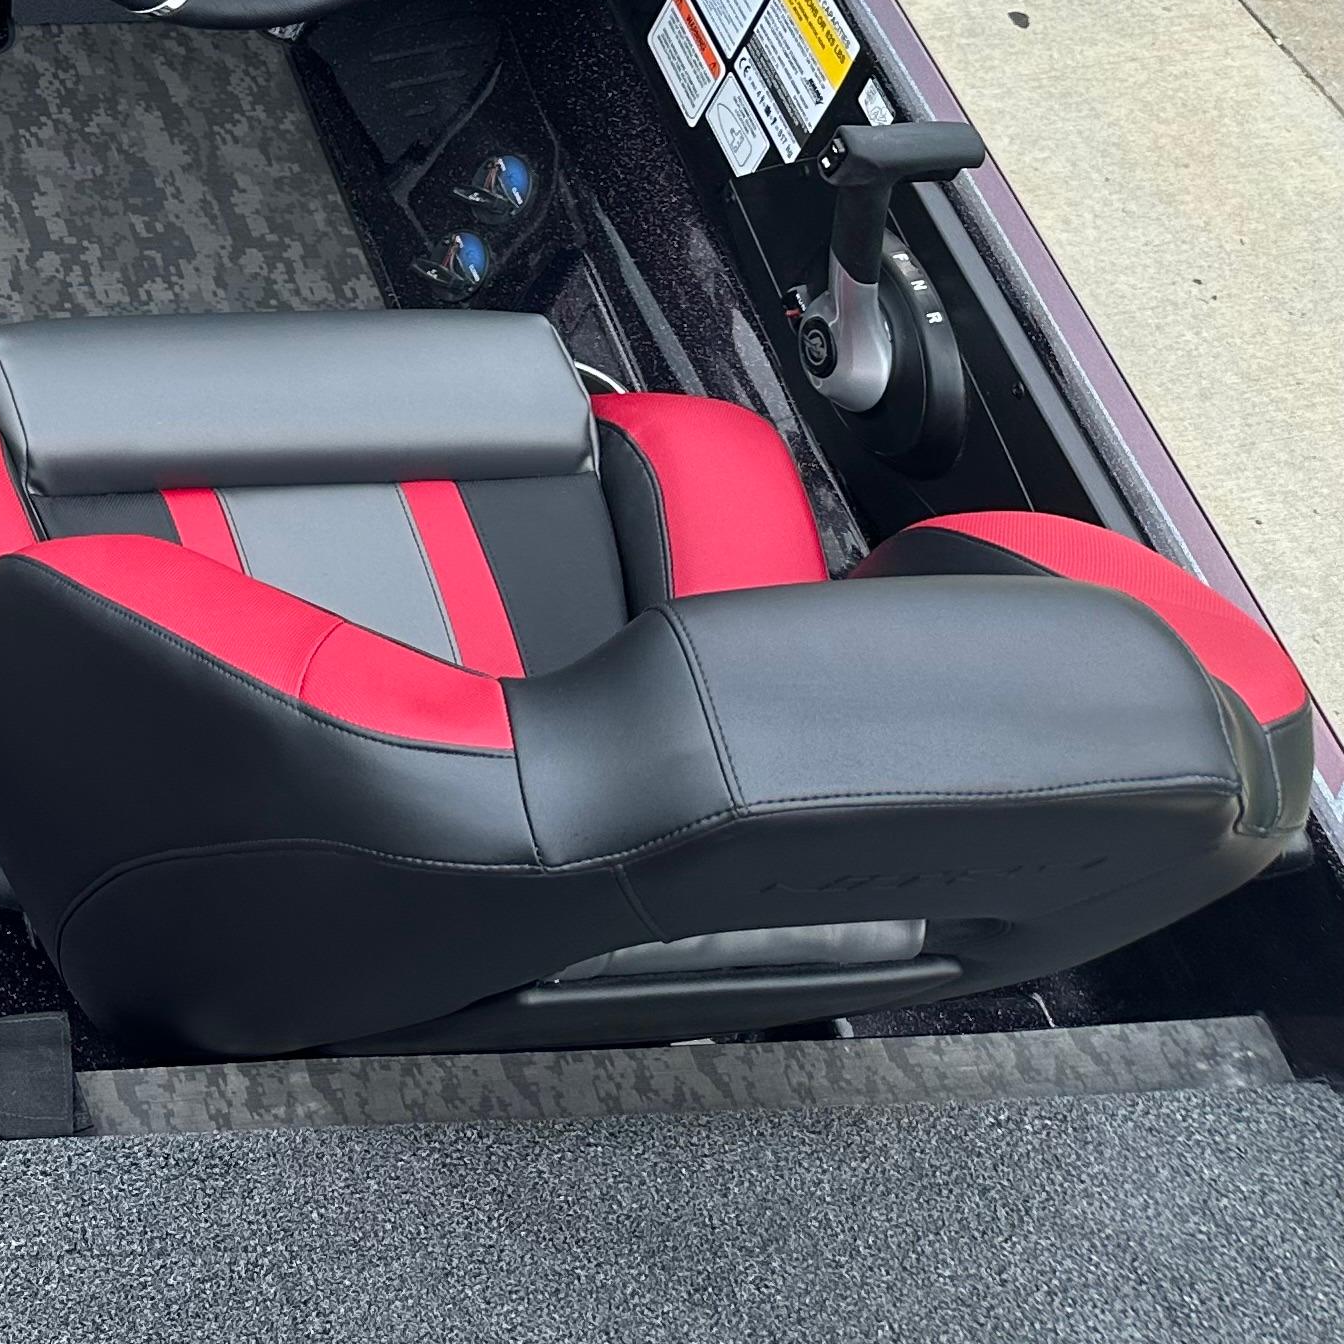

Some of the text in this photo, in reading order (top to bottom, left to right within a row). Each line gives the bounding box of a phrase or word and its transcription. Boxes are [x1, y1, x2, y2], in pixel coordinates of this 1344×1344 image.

[816, 14, 826, 31] OR
[821, 0, 851, 50] CAPACITIES
[892, 253, 909, 261] F
[911, 279, 928, 291] N
[926, 311, 943, 324] R
